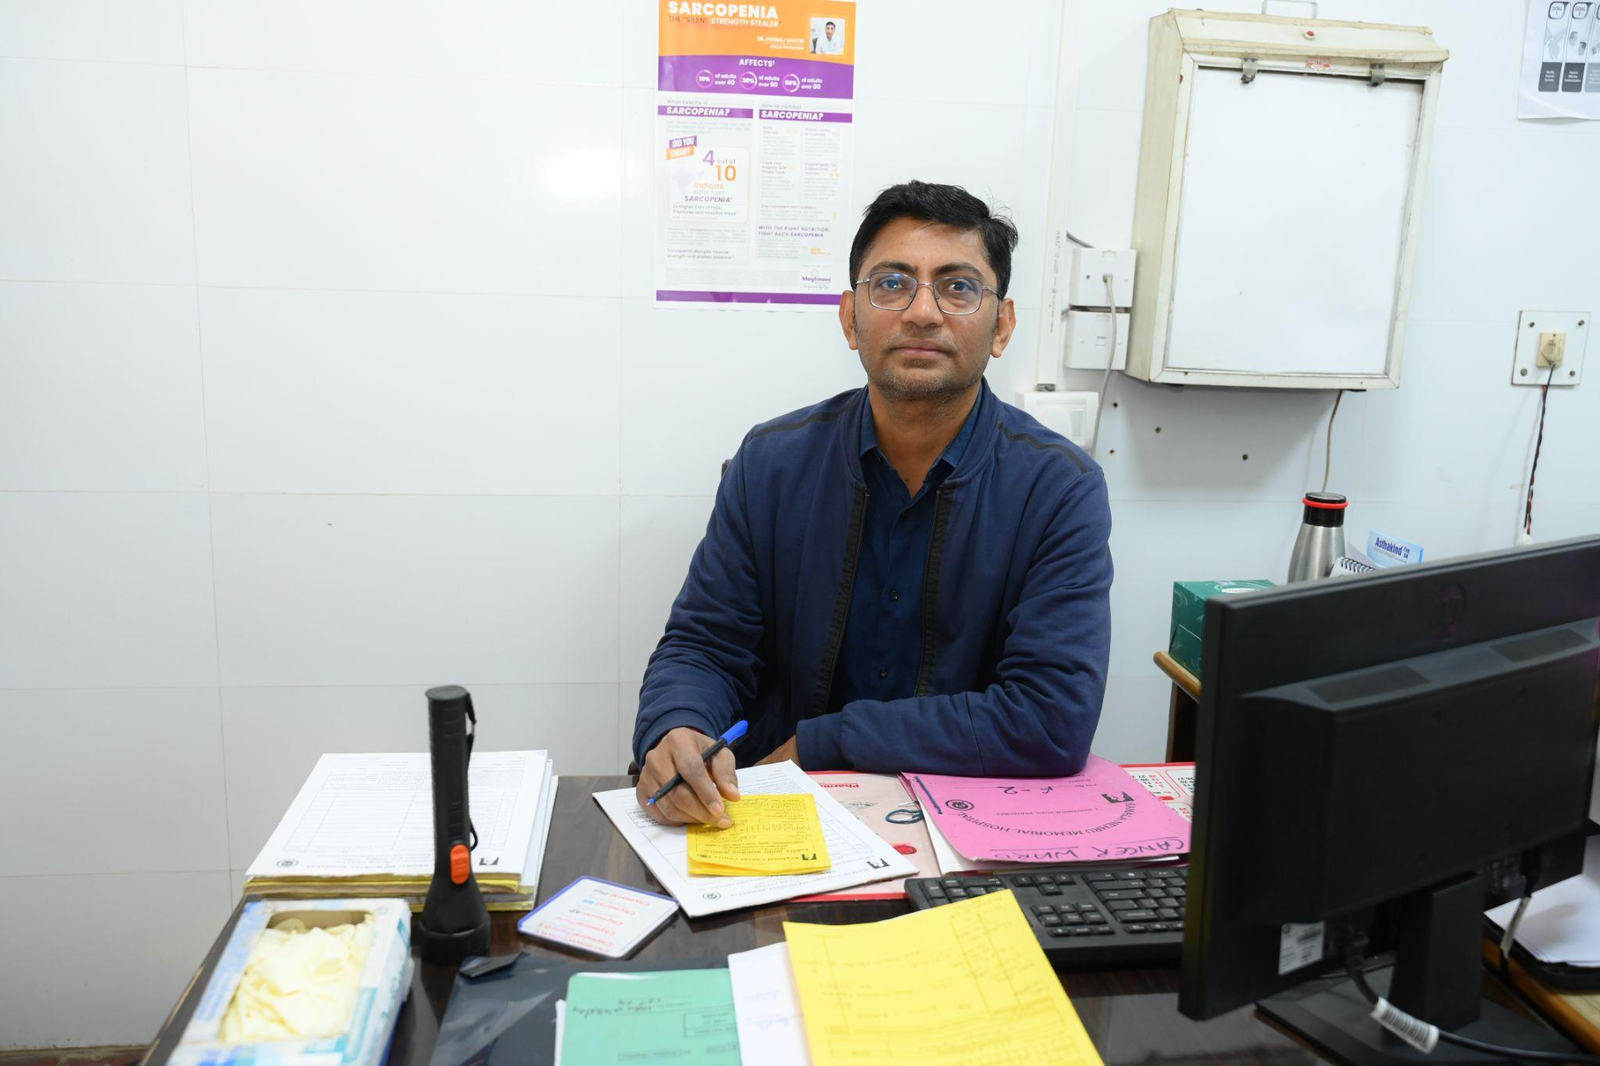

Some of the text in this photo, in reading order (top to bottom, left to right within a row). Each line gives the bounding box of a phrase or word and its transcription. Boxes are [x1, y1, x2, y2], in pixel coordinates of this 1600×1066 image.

[668, 1, 779, 19] SARCOPENIA
[666, 106, 730, 116] SARCOPENIA?
[761, 110, 824, 120] SARCOPENIA?
[702, 150, 715, 166] 4
[716, 164, 736, 181] 10
[958, 812, 1010, 833] HOSPITAL
[1085, 820, 1120, 834] NEHRU
[1014, 828, 1083, 836] MEMORIAL
[1091, 838, 1184, 858] CANCER
